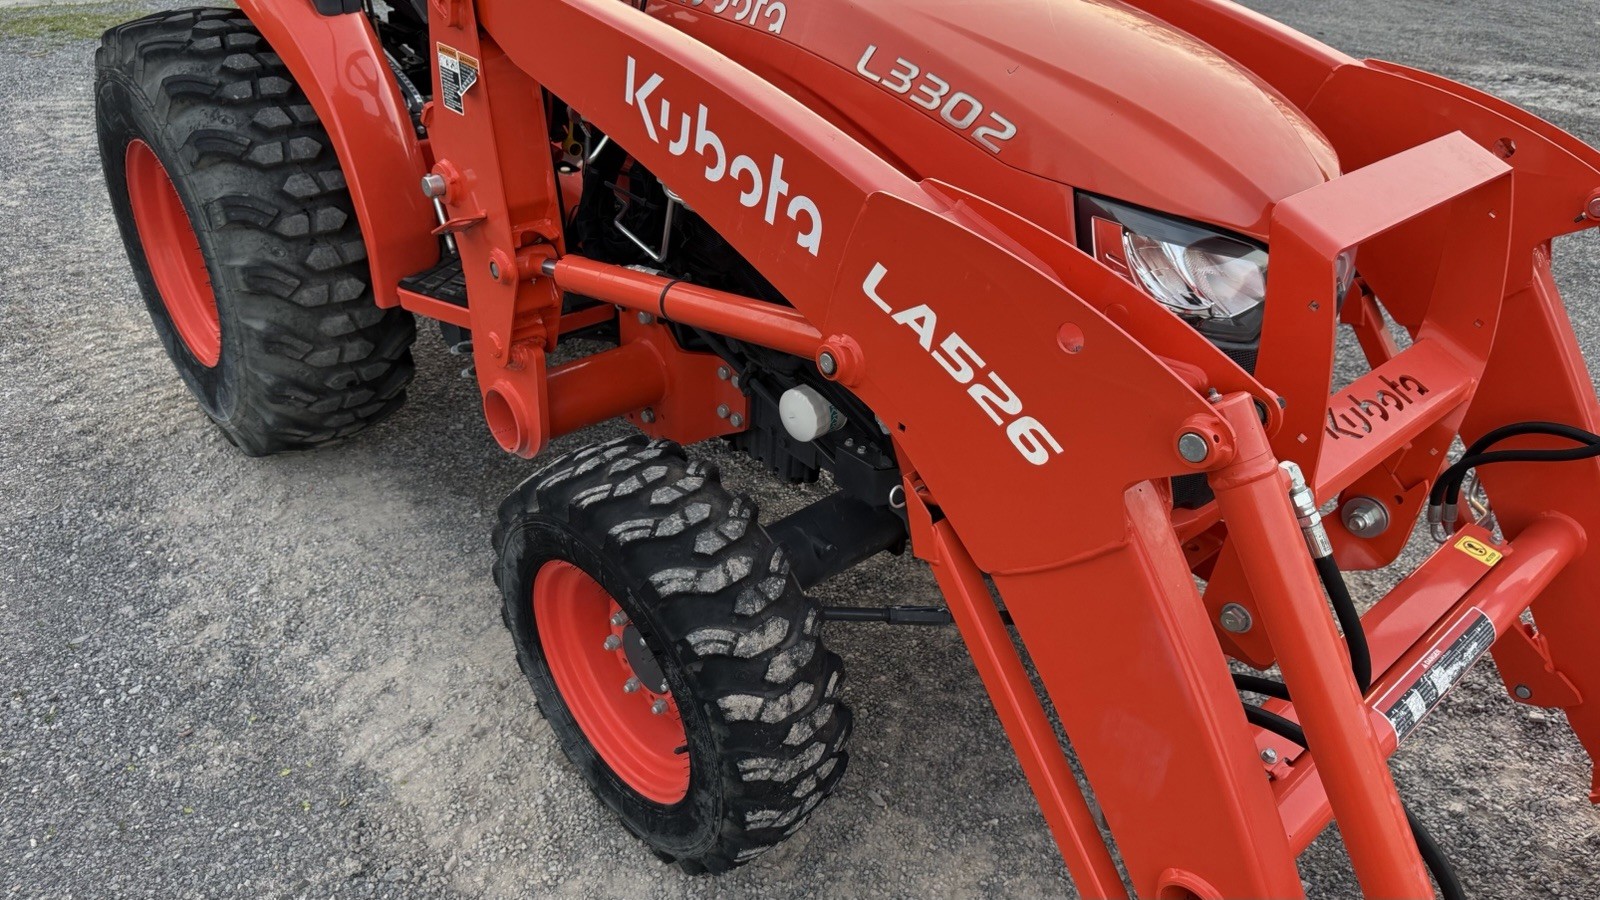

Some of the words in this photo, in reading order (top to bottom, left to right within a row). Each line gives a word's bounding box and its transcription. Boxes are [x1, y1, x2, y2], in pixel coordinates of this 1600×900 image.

[682, 0, 787, 34] ota
[856, 44, 1018, 155] L3302
[625, 55, 823, 258] Kubota
[862, 261, 1065, 466] LA526
[1325, 374, 1430, 440] Kubota
